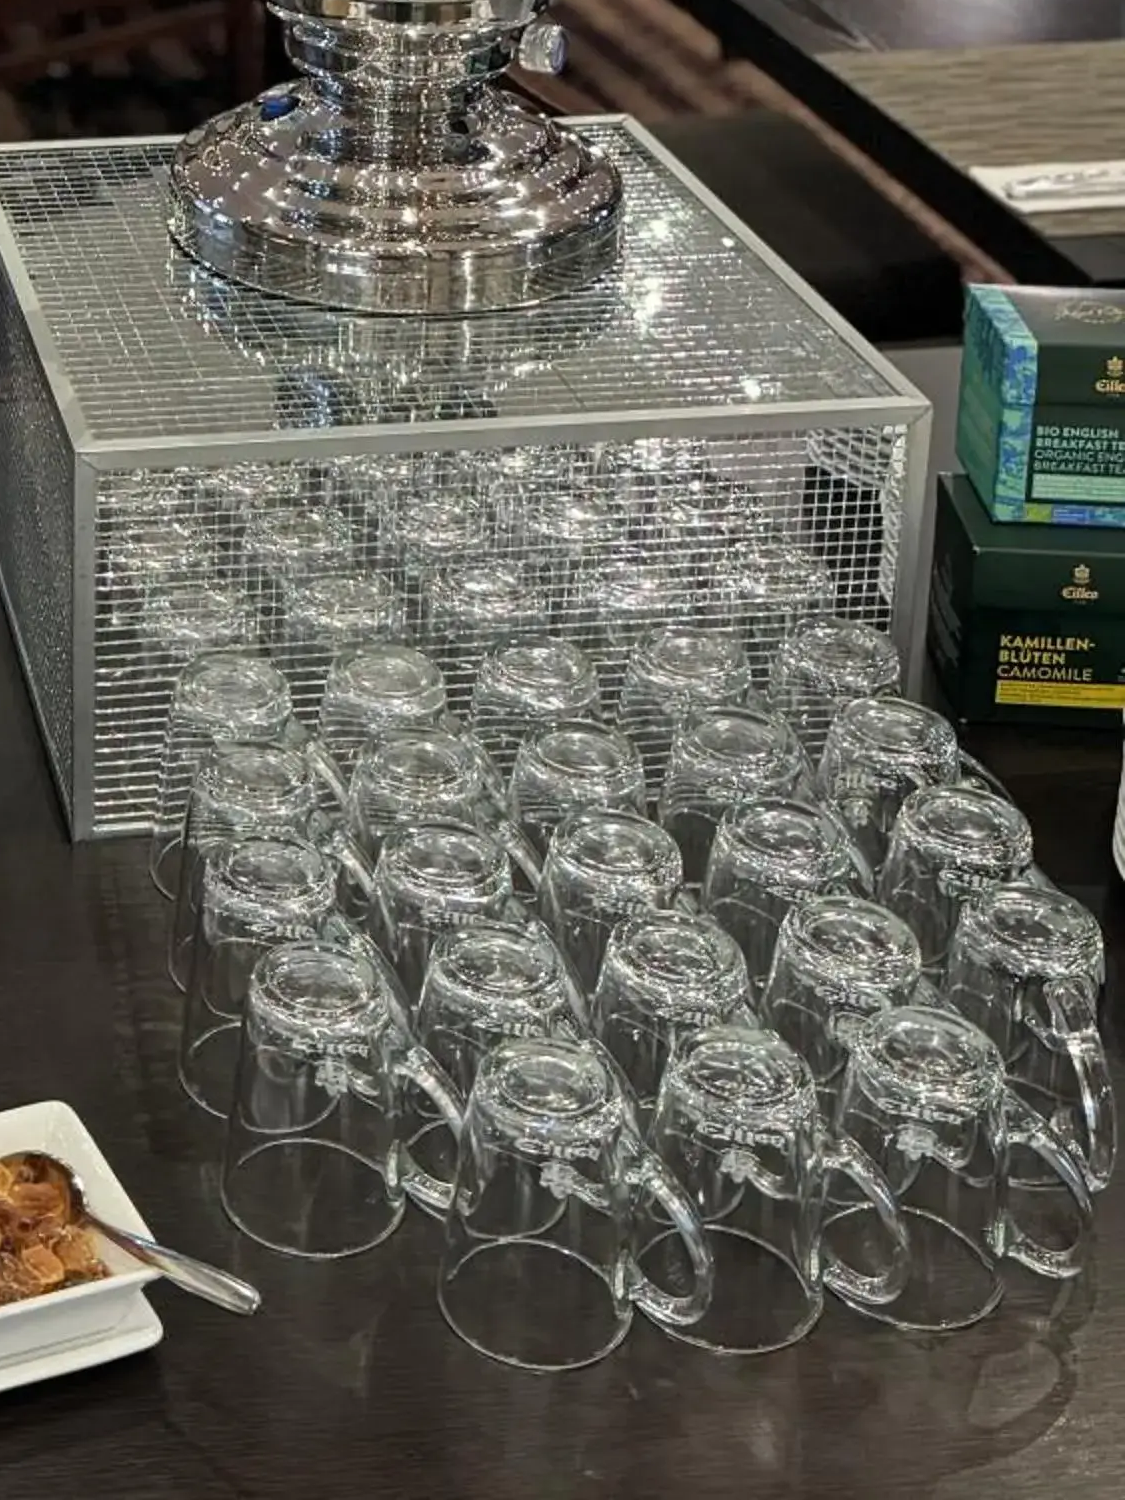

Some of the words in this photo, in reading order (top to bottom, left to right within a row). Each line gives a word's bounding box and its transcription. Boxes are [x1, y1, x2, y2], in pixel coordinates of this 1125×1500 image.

[1036, 426, 1060, 437] BIO
[1063, 427, 1119, 439] ENGLISH
[1036, 438, 1109, 451] BREAKFAST
[1111, 441, 1125, 451] TE
[1034, 450, 1095, 462] ORGANIC
[1033, 461, 1106, 474] BREAKFAST
[999, 634, 1096, 651] KAMILLEN-
[998, 648, 1066, 665] BLÜTEN
[996, 665, 1093, 681] CAMOMILE
